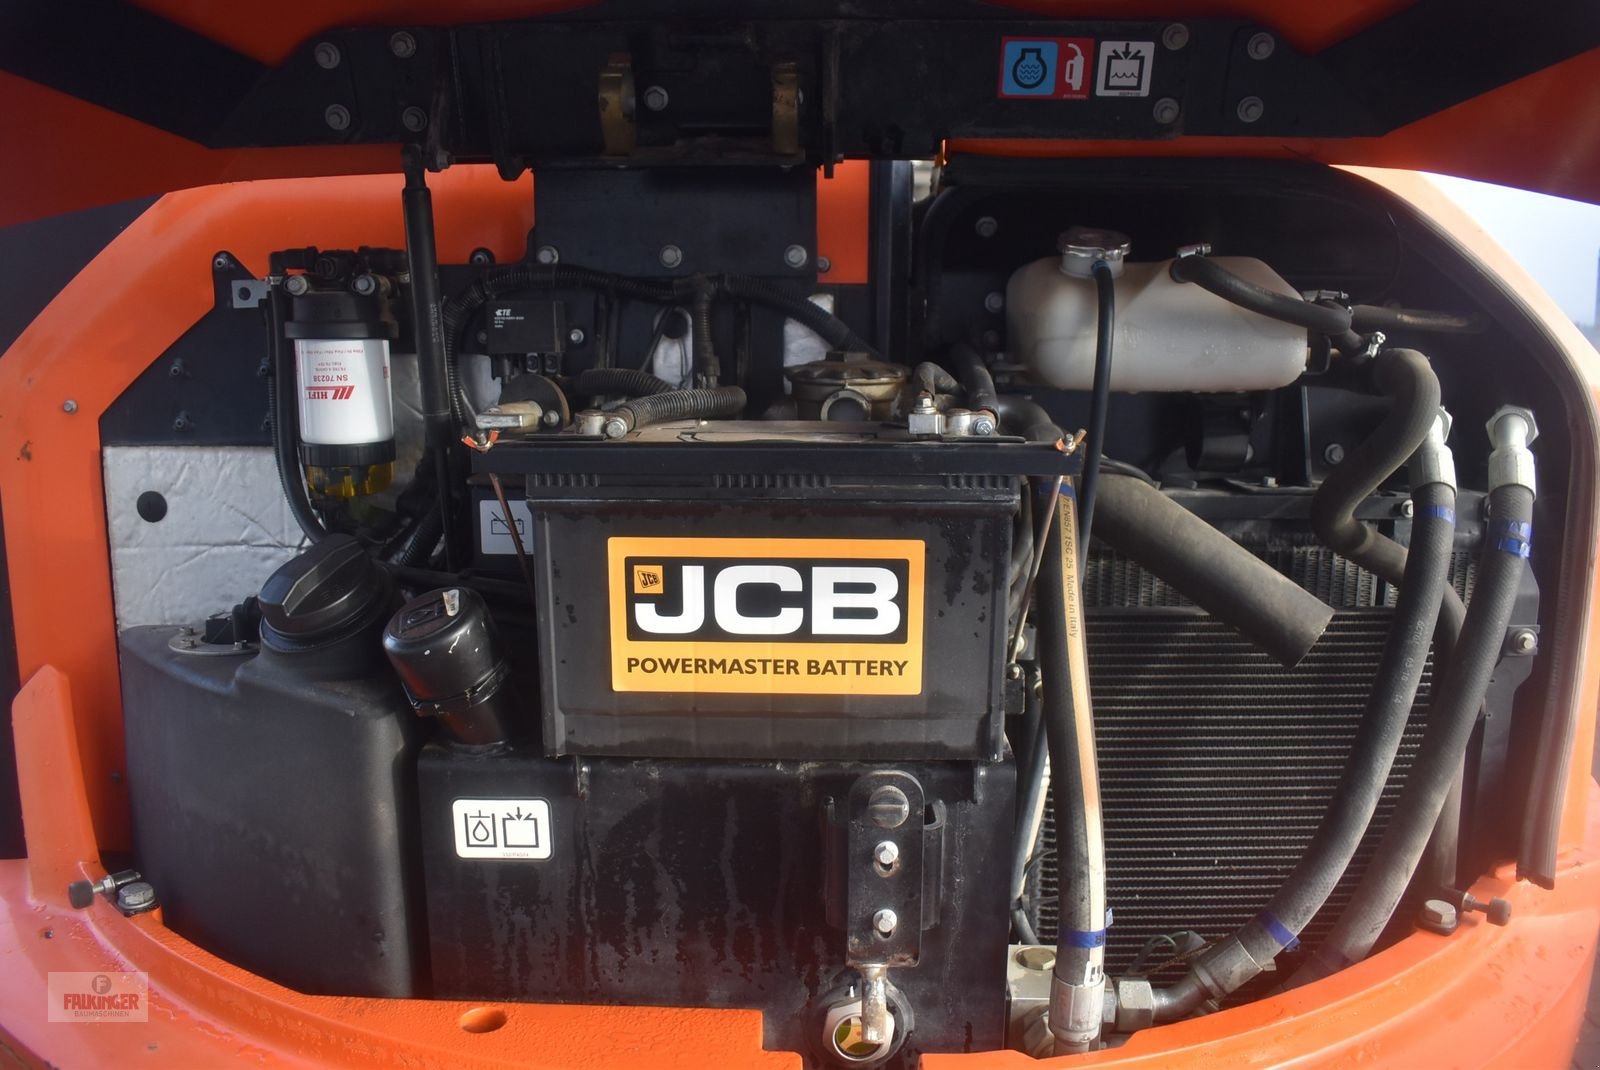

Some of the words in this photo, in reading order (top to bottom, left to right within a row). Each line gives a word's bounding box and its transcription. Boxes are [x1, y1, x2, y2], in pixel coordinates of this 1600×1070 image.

[313, 374, 335, 382] 70238
[336, 374, 348, 382] SN
[308, 391, 328, 400] HIFI
[1065, 557, 1074, 569] 25
[641, 572, 659, 586] JCB
[1066, 575, 1076, 601] Made
[635, 565, 901, 635] JCB
[1068, 604, 1076, 614] in
[1069, 617, 1079, 638] Italy
[627, 657, 800, 675] POWERMASTER
[807, 659, 909, 676] BATTERY
